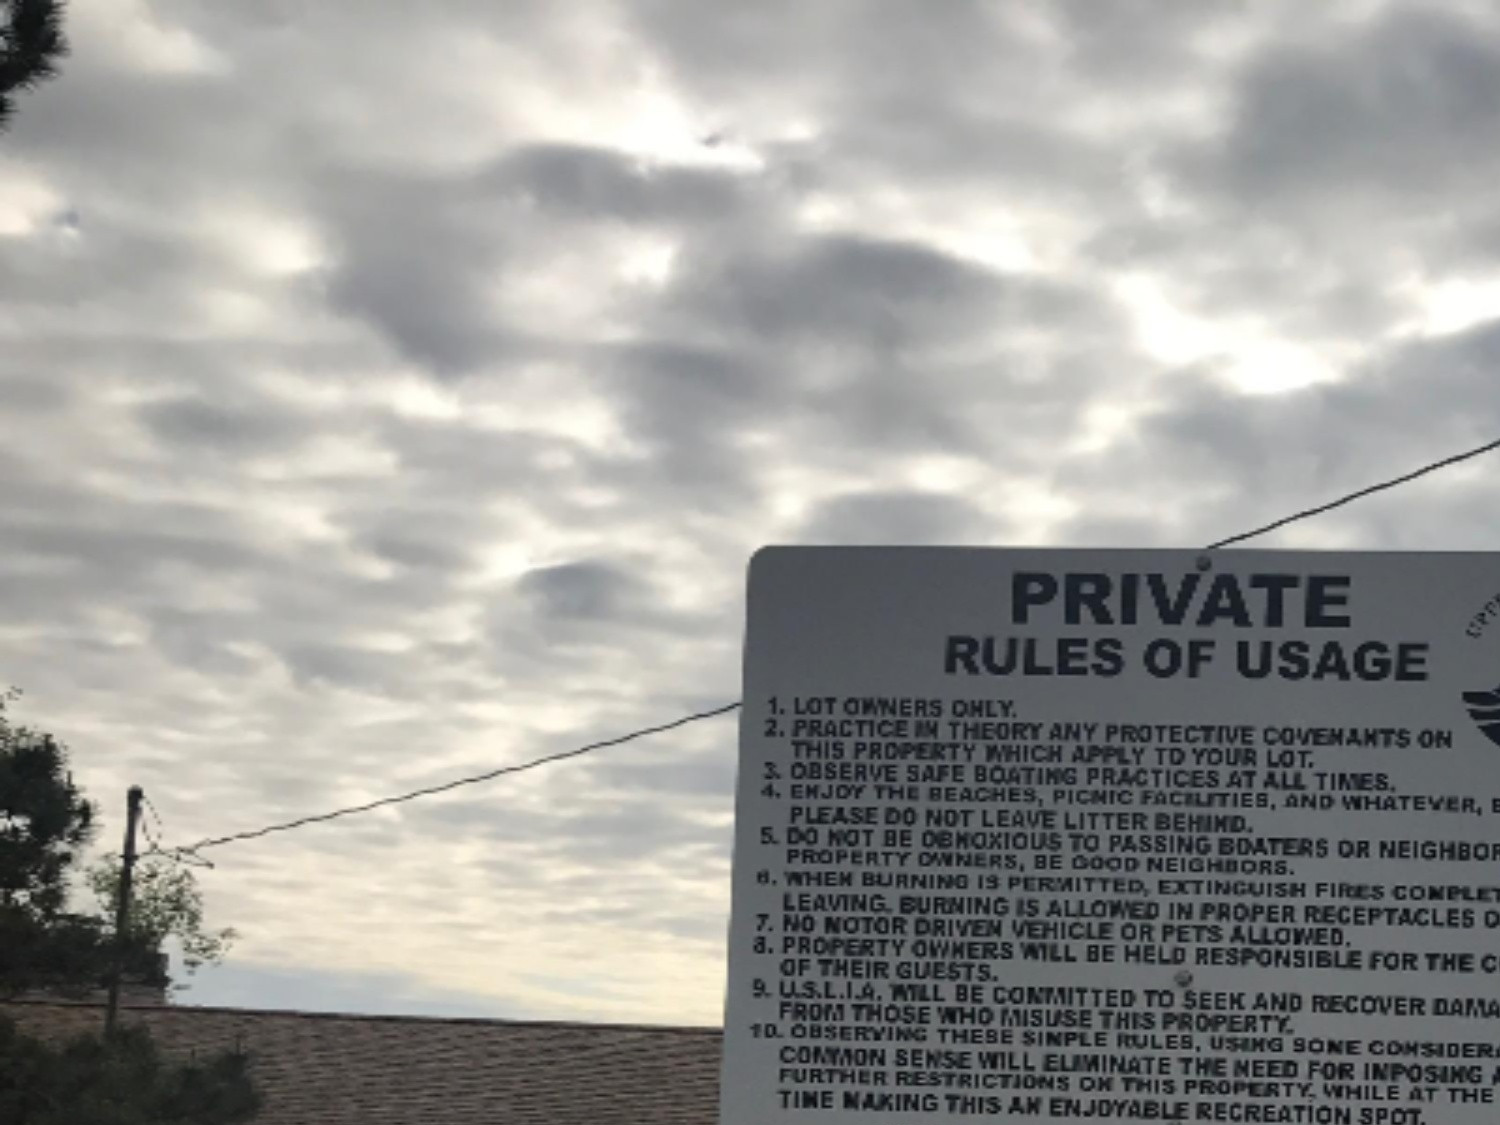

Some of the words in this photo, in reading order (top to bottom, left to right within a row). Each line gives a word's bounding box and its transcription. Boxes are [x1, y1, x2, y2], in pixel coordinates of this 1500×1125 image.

[1009, 570, 1352, 629] PRIVATE
[943, 635, 1127, 677] RULES
[1142, 638, 1216, 679] OF
[1235, 639, 1430, 682] USAGE
[767, 696, 785, 713] 1.
[794, 696, 837, 714] LOT
[842, 697, 942, 716] OWNERS
[952, 699, 1017, 717] ONLY.
[763, 717, 785, 737] 2.
[791, 718, 907, 738] PRACTICE
[948, 721, 1044, 740] THEORY
[1049, 722, 1099, 741] ANY
[1105, 723, 1255, 744] PROTECTIVE
[1262, 726, 1411, 747] COVENANTS
[1416, 728, 1452, 748] ON
[790, 740, 844, 759] THIS
[854, 741, 974, 761] PROPERTY
[986, 744, 1062, 762] WHICH
[1072, 745, 1144, 764] APPLY
[1154, 747, 1185, 765] TO
[1192, 747, 1256, 765] YOUR
[1267, 750, 1314, 767] LOT.
[791, 762, 897, 781] OBSERVE
[907, 764, 964, 783] SAFE
[974, 765, 1076, 785] BOATING
[1087, 767, 1219, 787] PRACTICES
[1226, 770, 1256, 788] AT
[1263, 771, 1306, 789] ALL
[1312, 772, 1396, 790] TIMES.
[760, 782, 782, 798] 4.
[873, 785, 918, 799] THE
[1283, 793, 1335, 808] AND
[1342, 793, 1483, 811] WHATEVER,
[789, 805, 878, 825] PLEASE
[884, 807, 915, 826] DO
[926, 809, 974, 827] NOT
[981, 808, 1055, 828] LEAVE
[1064, 811, 1148, 830] LITTER
[759, 826, 779, 844] 5.
[786, 827, 818, 845] DO
[829, 829, 873, 846] NOT
[883, 829, 912, 847] BE
[922, 830, 1061, 850] OBNOXIOUS
[1068, 833, 1099, 851] TO
[1109, 834, 1210, 853] PASSING
[1219, 836, 1329, 856] BOATERS
[1337, 839, 1371, 857] OR
[786, 848, 911, 866] PROPERTY
[1034, 854, 1061, 869] BE
[1072, 854, 1139, 871] GOOD
[1147, 857, 1294, 874] NEIGHBORS.
[862, 872, 968, 889] BURNING
[978, 875, 1000, 889] IS
[1157, 879, 1306, 897] EXTINGUISH
[900, 894, 1009, 916] BURNING
[1016, 899, 1039, 917] IS
[1046, 899, 1159, 919] ALLOWED
[1169, 902, 1193, 920] IN
[1200, 902, 1295, 923] PROPER
[1304, 905, 1475, 927] RECEPTACLES
[755, 913, 774, 932] 7.
[782, 914, 814, 932] NO
[825, 915, 907, 935] MOTOR
[915, 918, 1001, 937] DRIVEN
[1012, 920, 1112, 940] VEHICLE
[1120, 923, 1153, 941] OR
[1161, 924, 1223, 943] PETS
[1230, 926, 1351, 946] ALLOWED.
[781, 936, 905, 956] PROPERTY
[911, 939, 1014, 960] OWNERS
[1019, 942, 1078, 963] WILL
[1085, 944, 1115, 963] BE
[1123, 944, 1186, 965] HELD
[1194, 946, 1362, 970] RESPONSIBLE
[1368, 950, 1419, 971] FOR
[1423, 952, 1475, 972] THE
[779, 958, 810, 976] OF
[817, 959, 889, 978] THEIR
[895, 961, 998, 981] GUESTS.
[892, 984, 946, 1002] WILL
[956, 984, 984, 1003] BE
[992, 984, 1137, 1008] COMMITTED
[1142, 988, 1174, 1007] TO
[1182, 989, 1245, 1010] SEEK
[1252, 991, 1303, 1012] AND
[1310, 993, 1427, 1015] RECOVER
[778, 1001, 844, 1022] FROM
[850, 1003, 931, 1024] THOSE
[936, 1006, 994, 1025] WHO
[1000, 1008, 1092, 1028] MISUSE
[1098, 1011, 1155, 1030] THIS
[936, 1028, 1013, 1044] THESE
[1210, 1035, 1284, 1052] USING
[894, 1049, 972, 1069] SENSE
[978, 1051, 1036, 1070] WILL
[1177, 1056, 1226, 1076] THE
[1234, 1059, 1299, 1078] NEED
[1307, 1060, 1355, 1079] FOR
[778, 1067, 886, 1086] FURTHER
[895, 1070, 1069, 1091] RESTRICTIONS
[1121, 1077, 1176, 1094] THIS
[1323, 1083, 1400, 1100] WHILE
[1409, 1087, 1437, 1102] AT
[1447, 1087, 1494, 1104] THE
[943, 1094, 1003, 1115] THIS
[1049, 1097, 1189, 1121] ENJOYABLE
[1195, 1101, 1351, 1125] RECREATION
